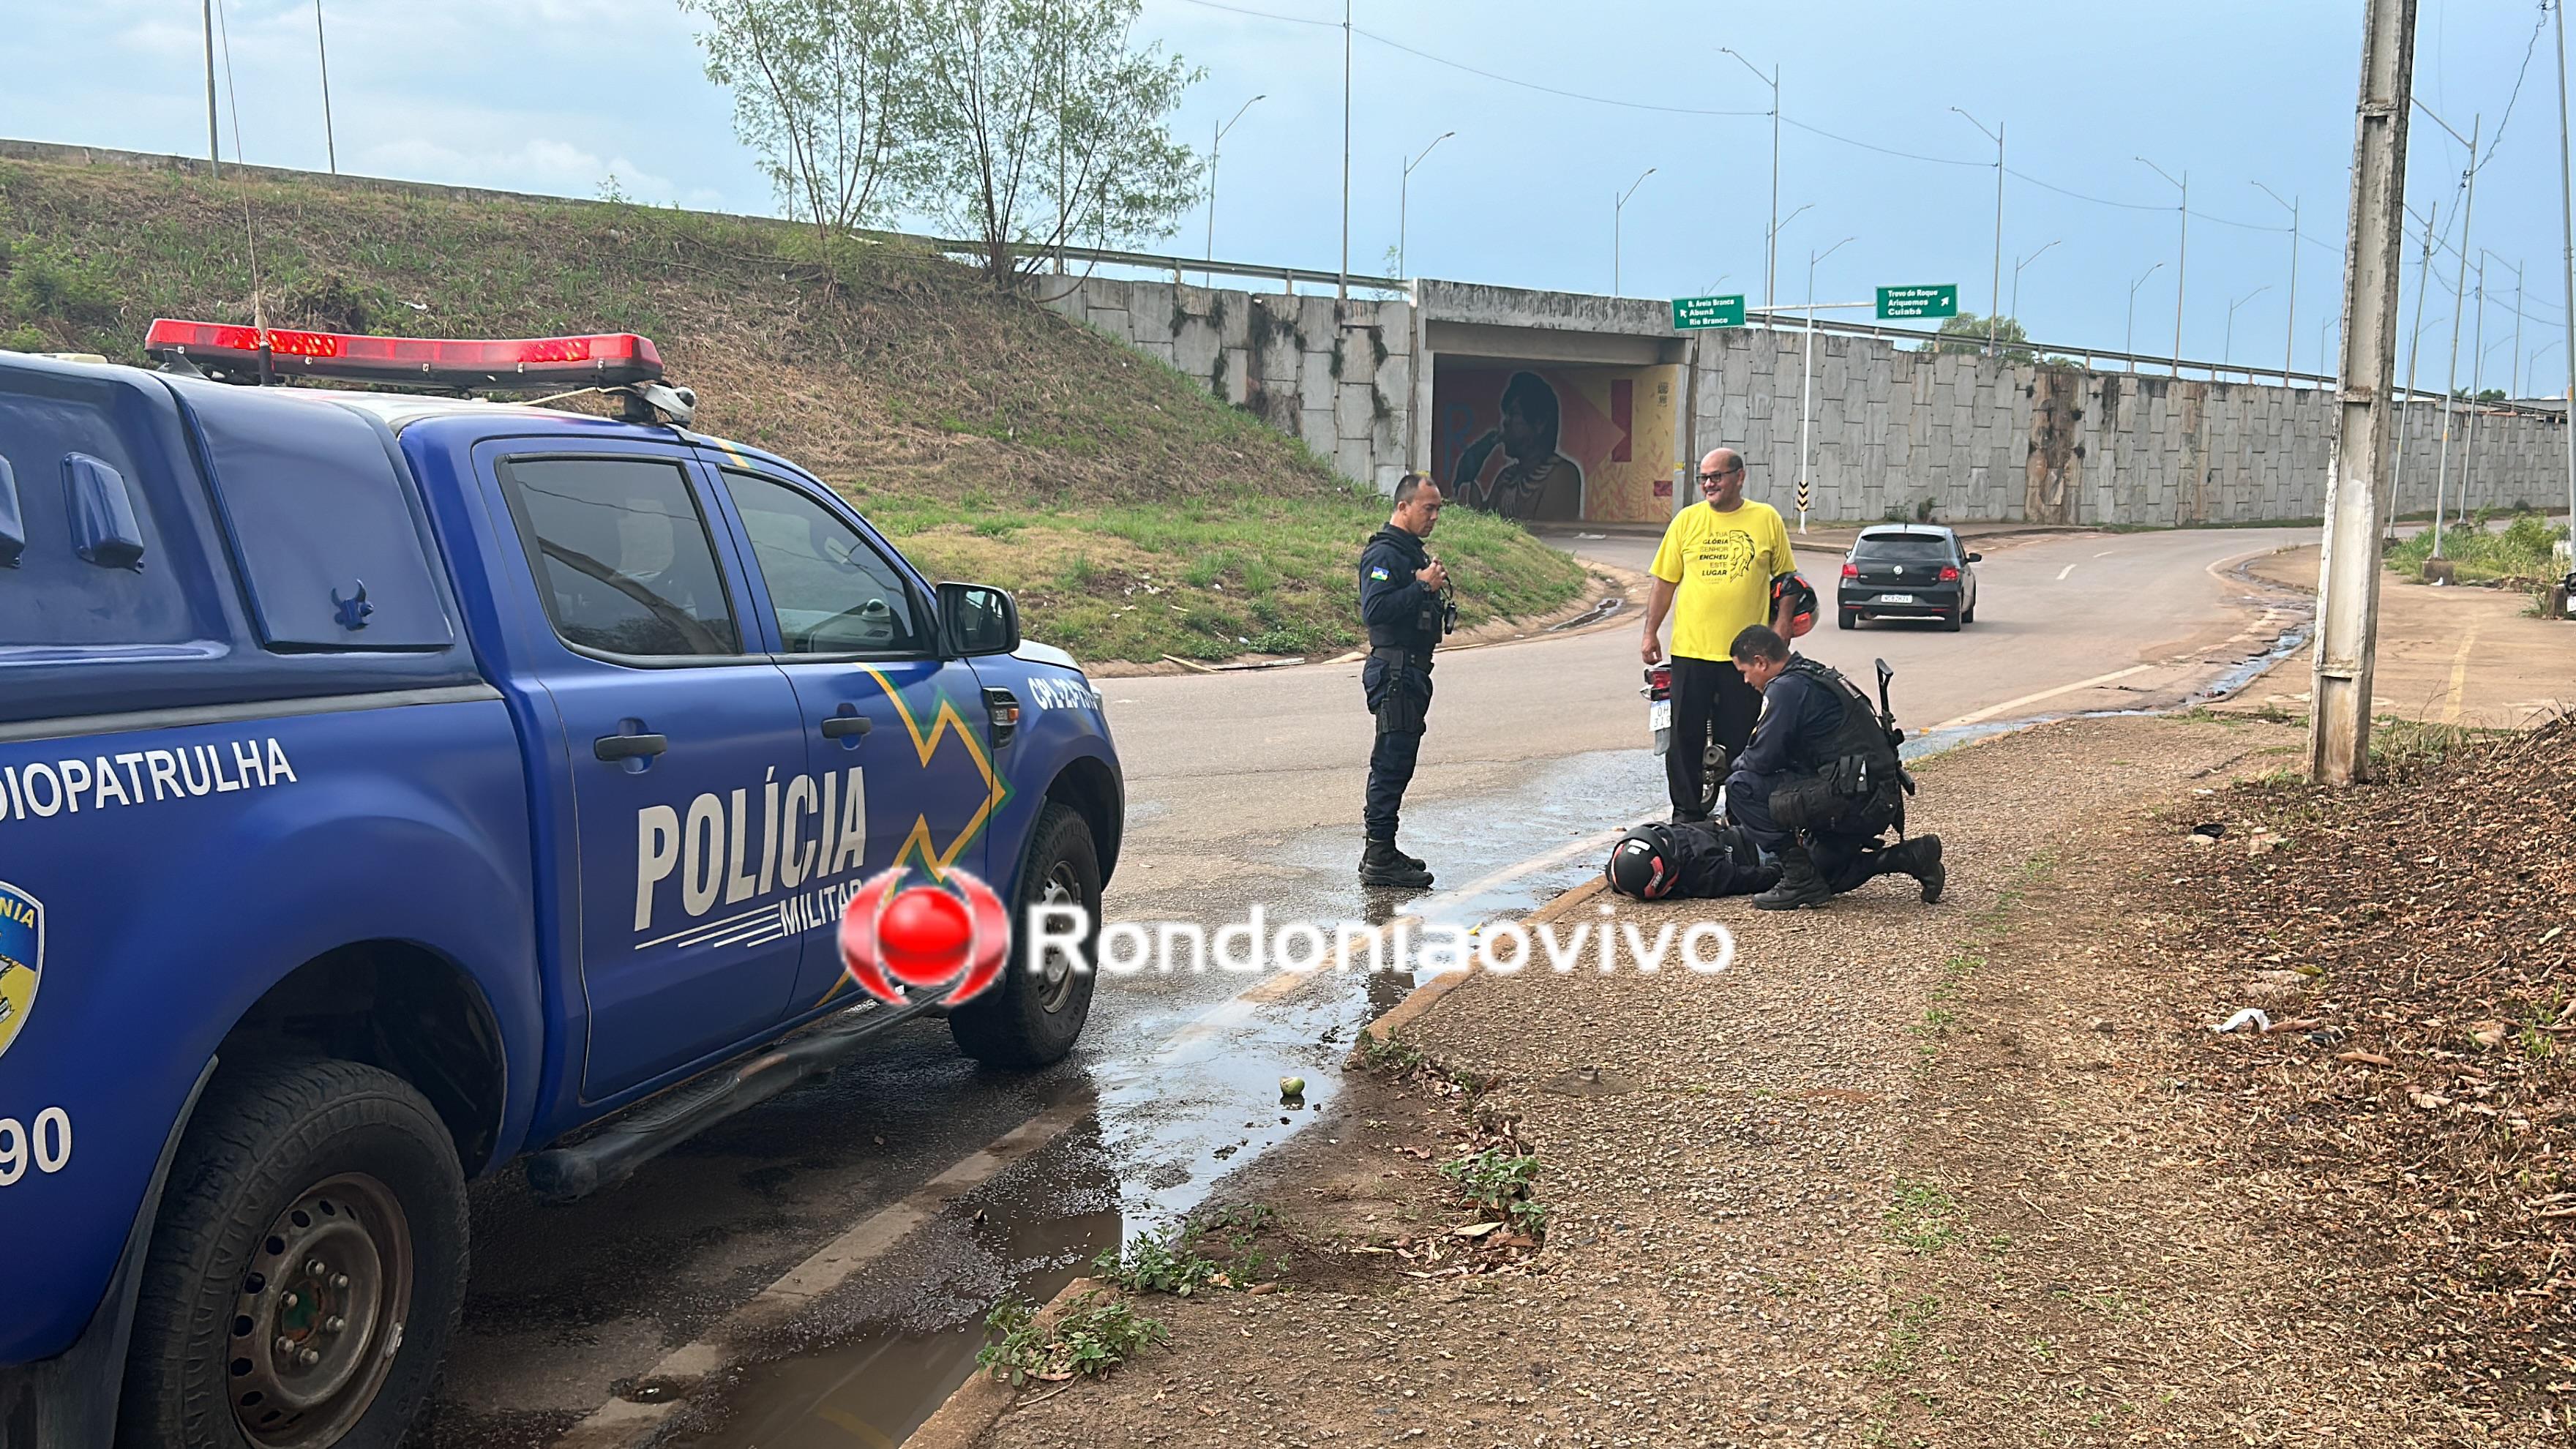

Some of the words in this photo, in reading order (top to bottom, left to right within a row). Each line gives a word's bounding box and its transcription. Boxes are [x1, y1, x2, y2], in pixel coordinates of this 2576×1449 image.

[1887, 307, 1922, 315] Cuiabá
[1917, 290, 1938, 298] Roque
[1689, 318, 1701, 326] Rio
[1702, 317, 1729, 325] Branco
[0, 737, 297, 823] IOPATRULHA
[634, 765, 867, 932] POLÍCIA
[0, 1107, 72, 1186] 90
